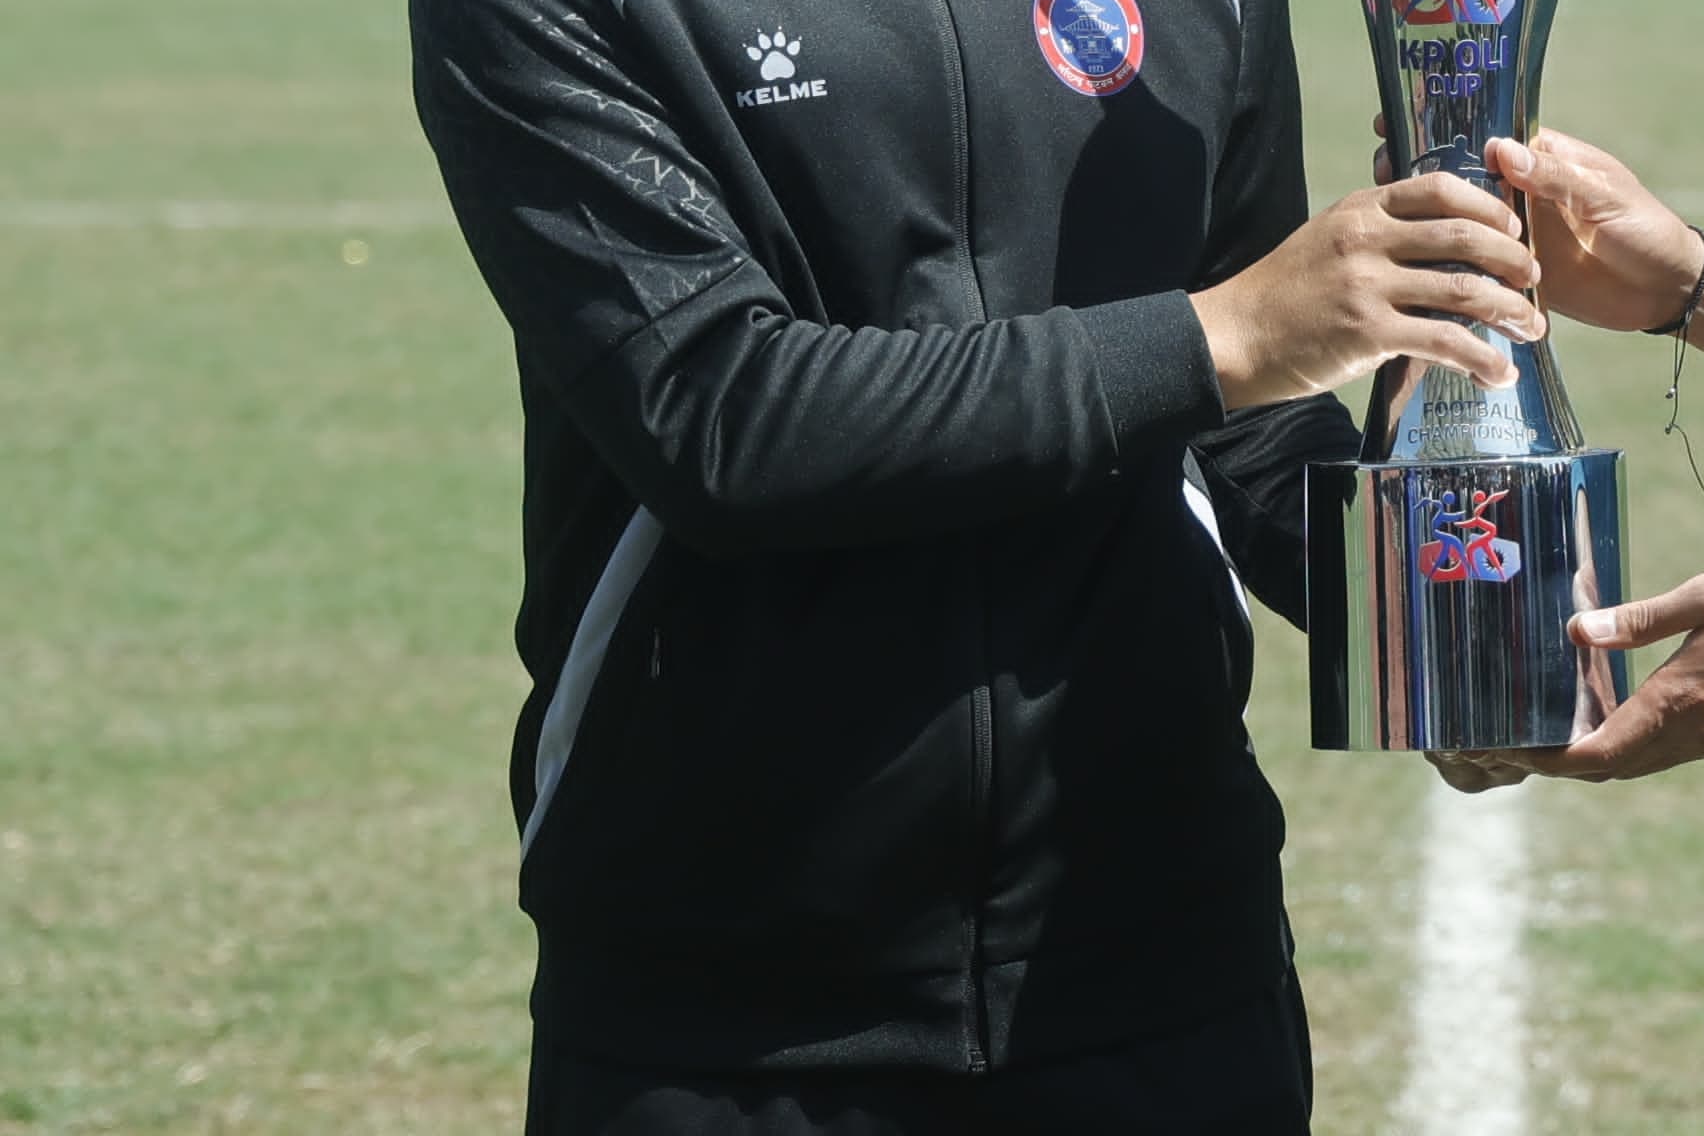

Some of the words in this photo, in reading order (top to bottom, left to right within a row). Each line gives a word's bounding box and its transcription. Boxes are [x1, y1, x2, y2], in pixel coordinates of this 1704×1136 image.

[1400, 38, 1446, 70] KP
[1455, 34, 1511, 72] OLI
[736, 79, 828, 108] KELME
[1426, 72, 1482, 97] CUP
[1423, 399, 1524, 421] FOOTBALL
